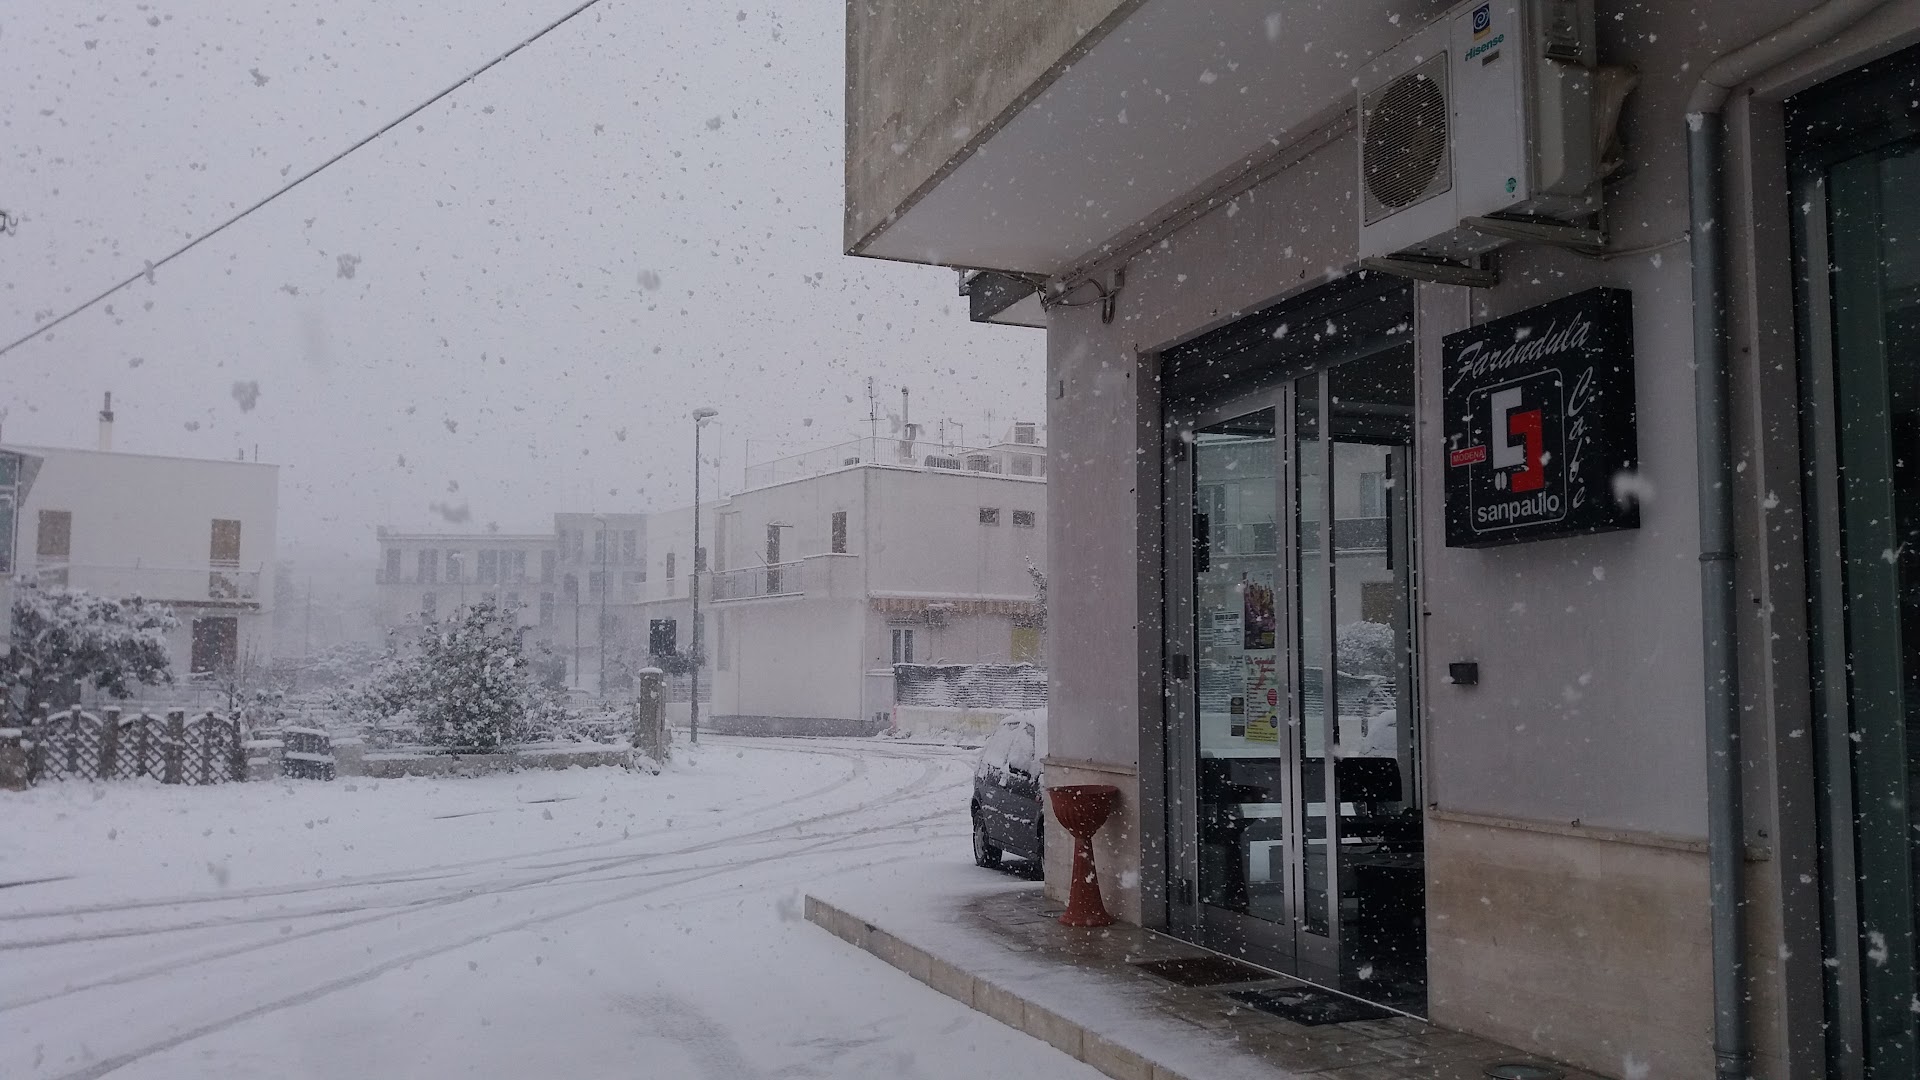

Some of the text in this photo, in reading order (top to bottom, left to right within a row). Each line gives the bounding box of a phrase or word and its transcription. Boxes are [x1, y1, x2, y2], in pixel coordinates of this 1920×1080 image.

[1465, 33, 1504, 61] Hisense
[1448, 311, 1591, 394] Farandula
[1453, 449, 1485, 463] MODENA
[1476, 492, 1560, 523] sanpaulo
